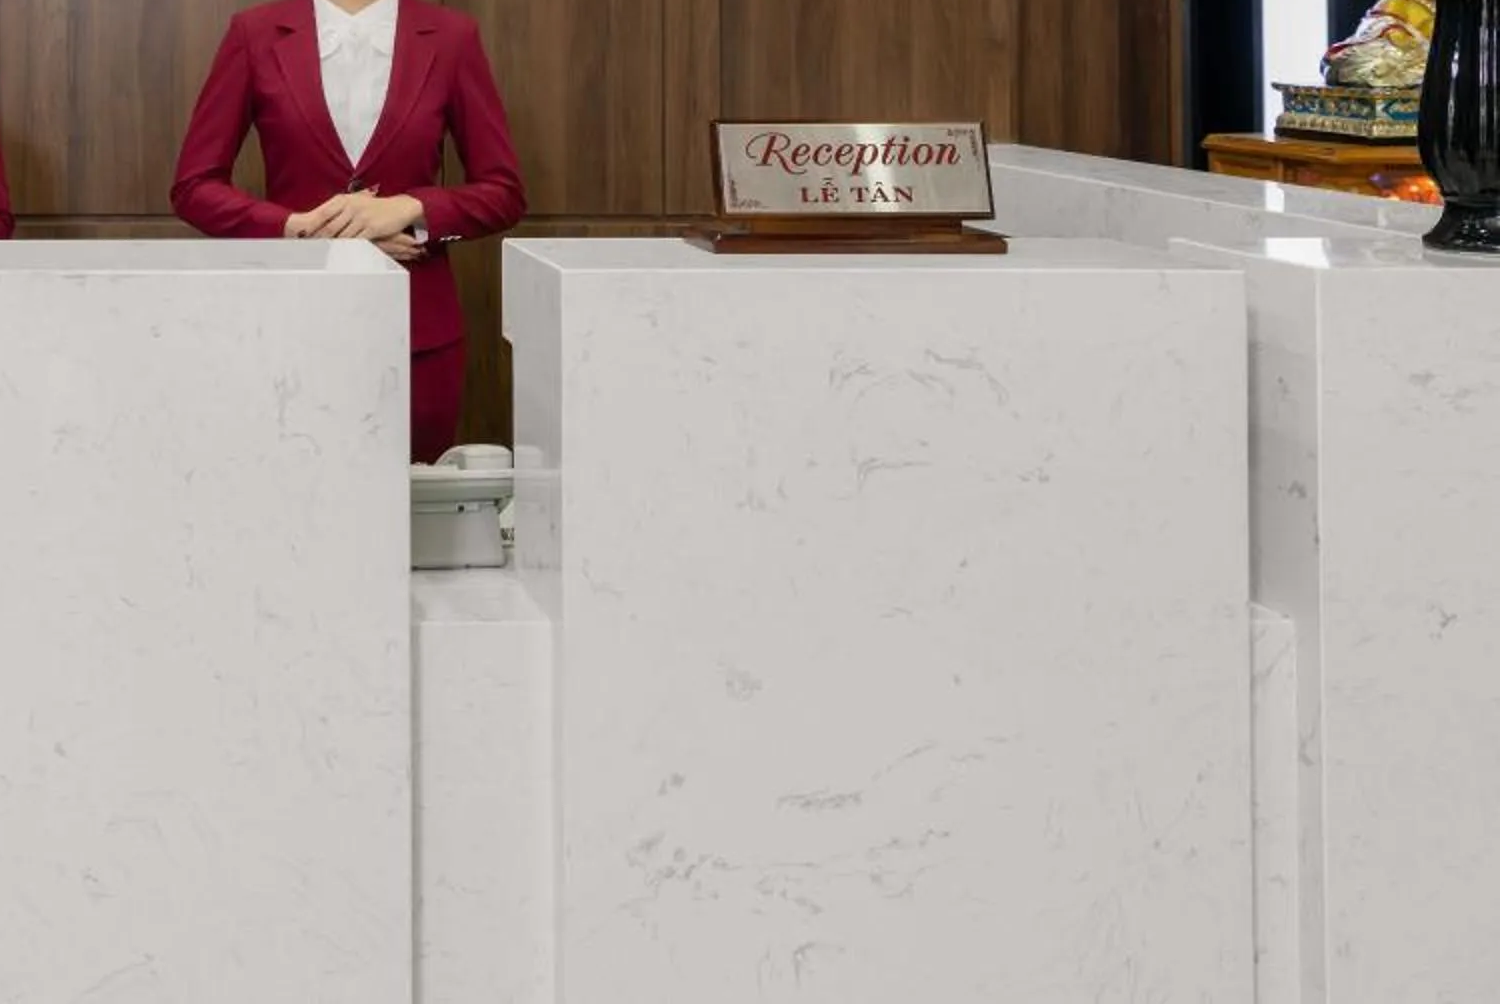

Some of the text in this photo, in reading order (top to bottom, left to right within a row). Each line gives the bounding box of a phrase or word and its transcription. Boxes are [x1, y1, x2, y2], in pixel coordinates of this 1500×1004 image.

[746, 132, 961, 176] Reception
[800, 178, 914, 203] LỄ TÂN
